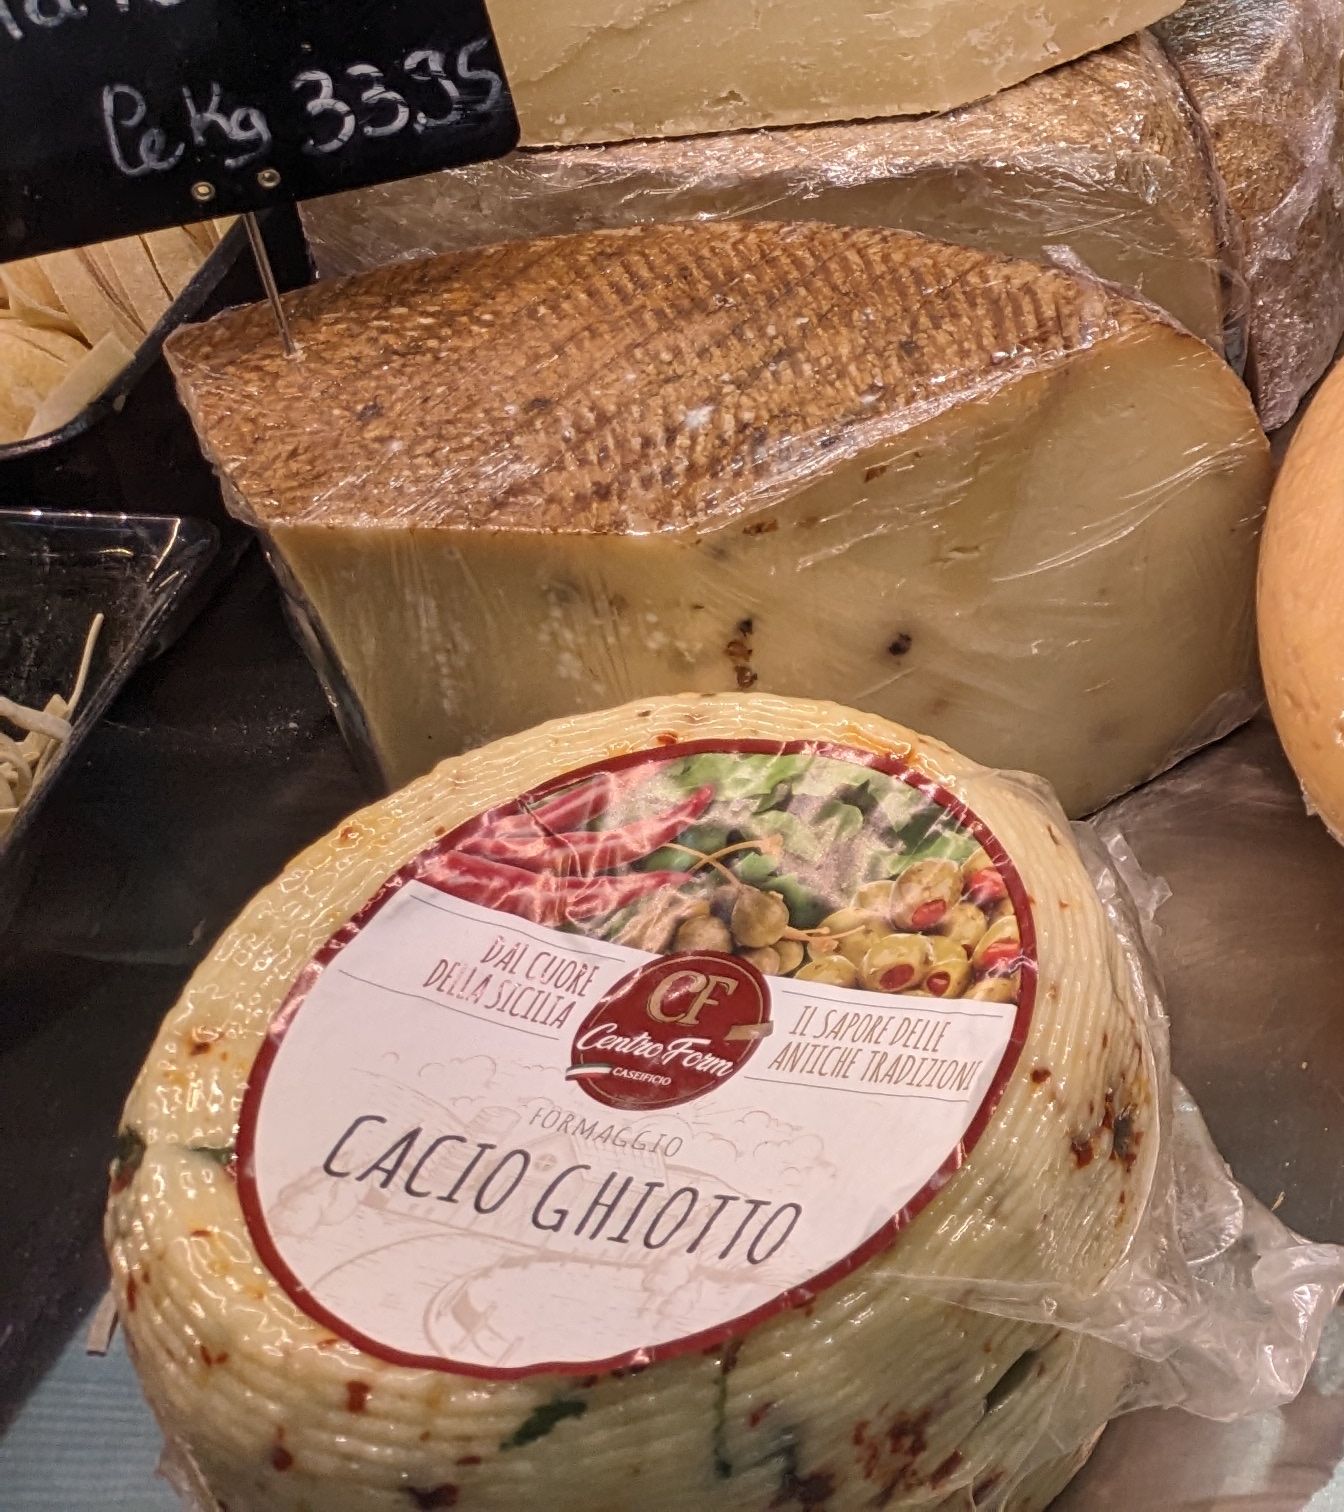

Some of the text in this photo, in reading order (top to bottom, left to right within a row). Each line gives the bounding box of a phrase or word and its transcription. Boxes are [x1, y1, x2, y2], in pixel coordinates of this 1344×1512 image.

[480, 934, 601, 999] DAL CUORE
[422, 958, 580, 1031] DELLA SICILIA
[789, 1004, 953, 1054] IL SAPORE DELLE
[612, 1066, 672, 1088] CASEIFICIO
[767, 1040, 984, 1093] ANTICHE TRADIZIONI
[529, 1106, 684, 1158] FORMAGGIO
[322, 1114, 803, 1266] CACIO GHIOTTO
